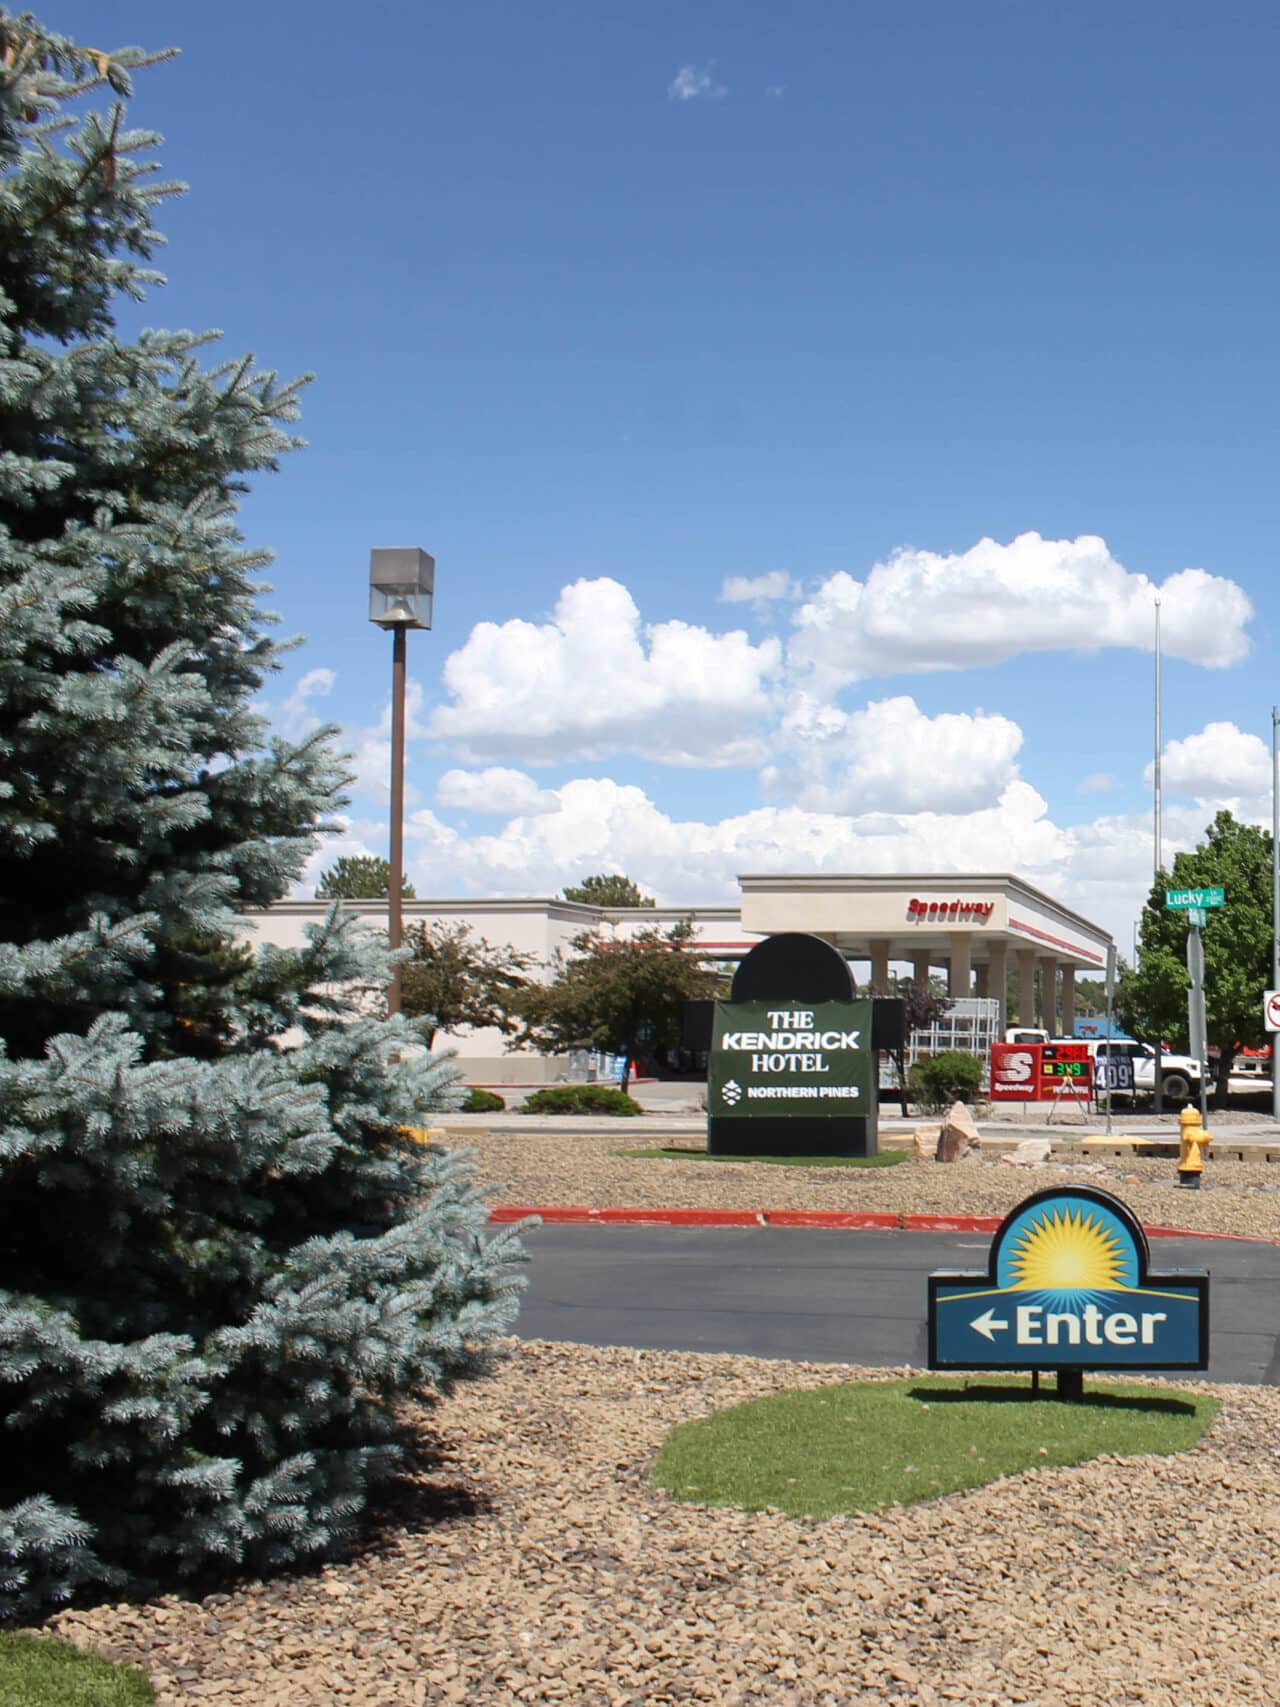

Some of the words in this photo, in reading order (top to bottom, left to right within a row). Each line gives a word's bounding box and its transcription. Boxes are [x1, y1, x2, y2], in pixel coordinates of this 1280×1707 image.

[908, 898, 995, 916] Speedway
[1166, 889, 1204, 907] Lucky
[767, 1011, 814, 1029] THE
[722, 1031, 860, 1051] KENDRICK
[751, 1053, 829, 1073] HOTEL
[747, 1086, 818, 1098] NORTHERN
[819, 1086, 860, 1098] PINES
[1016, 1304, 1168, 1345] Enter
